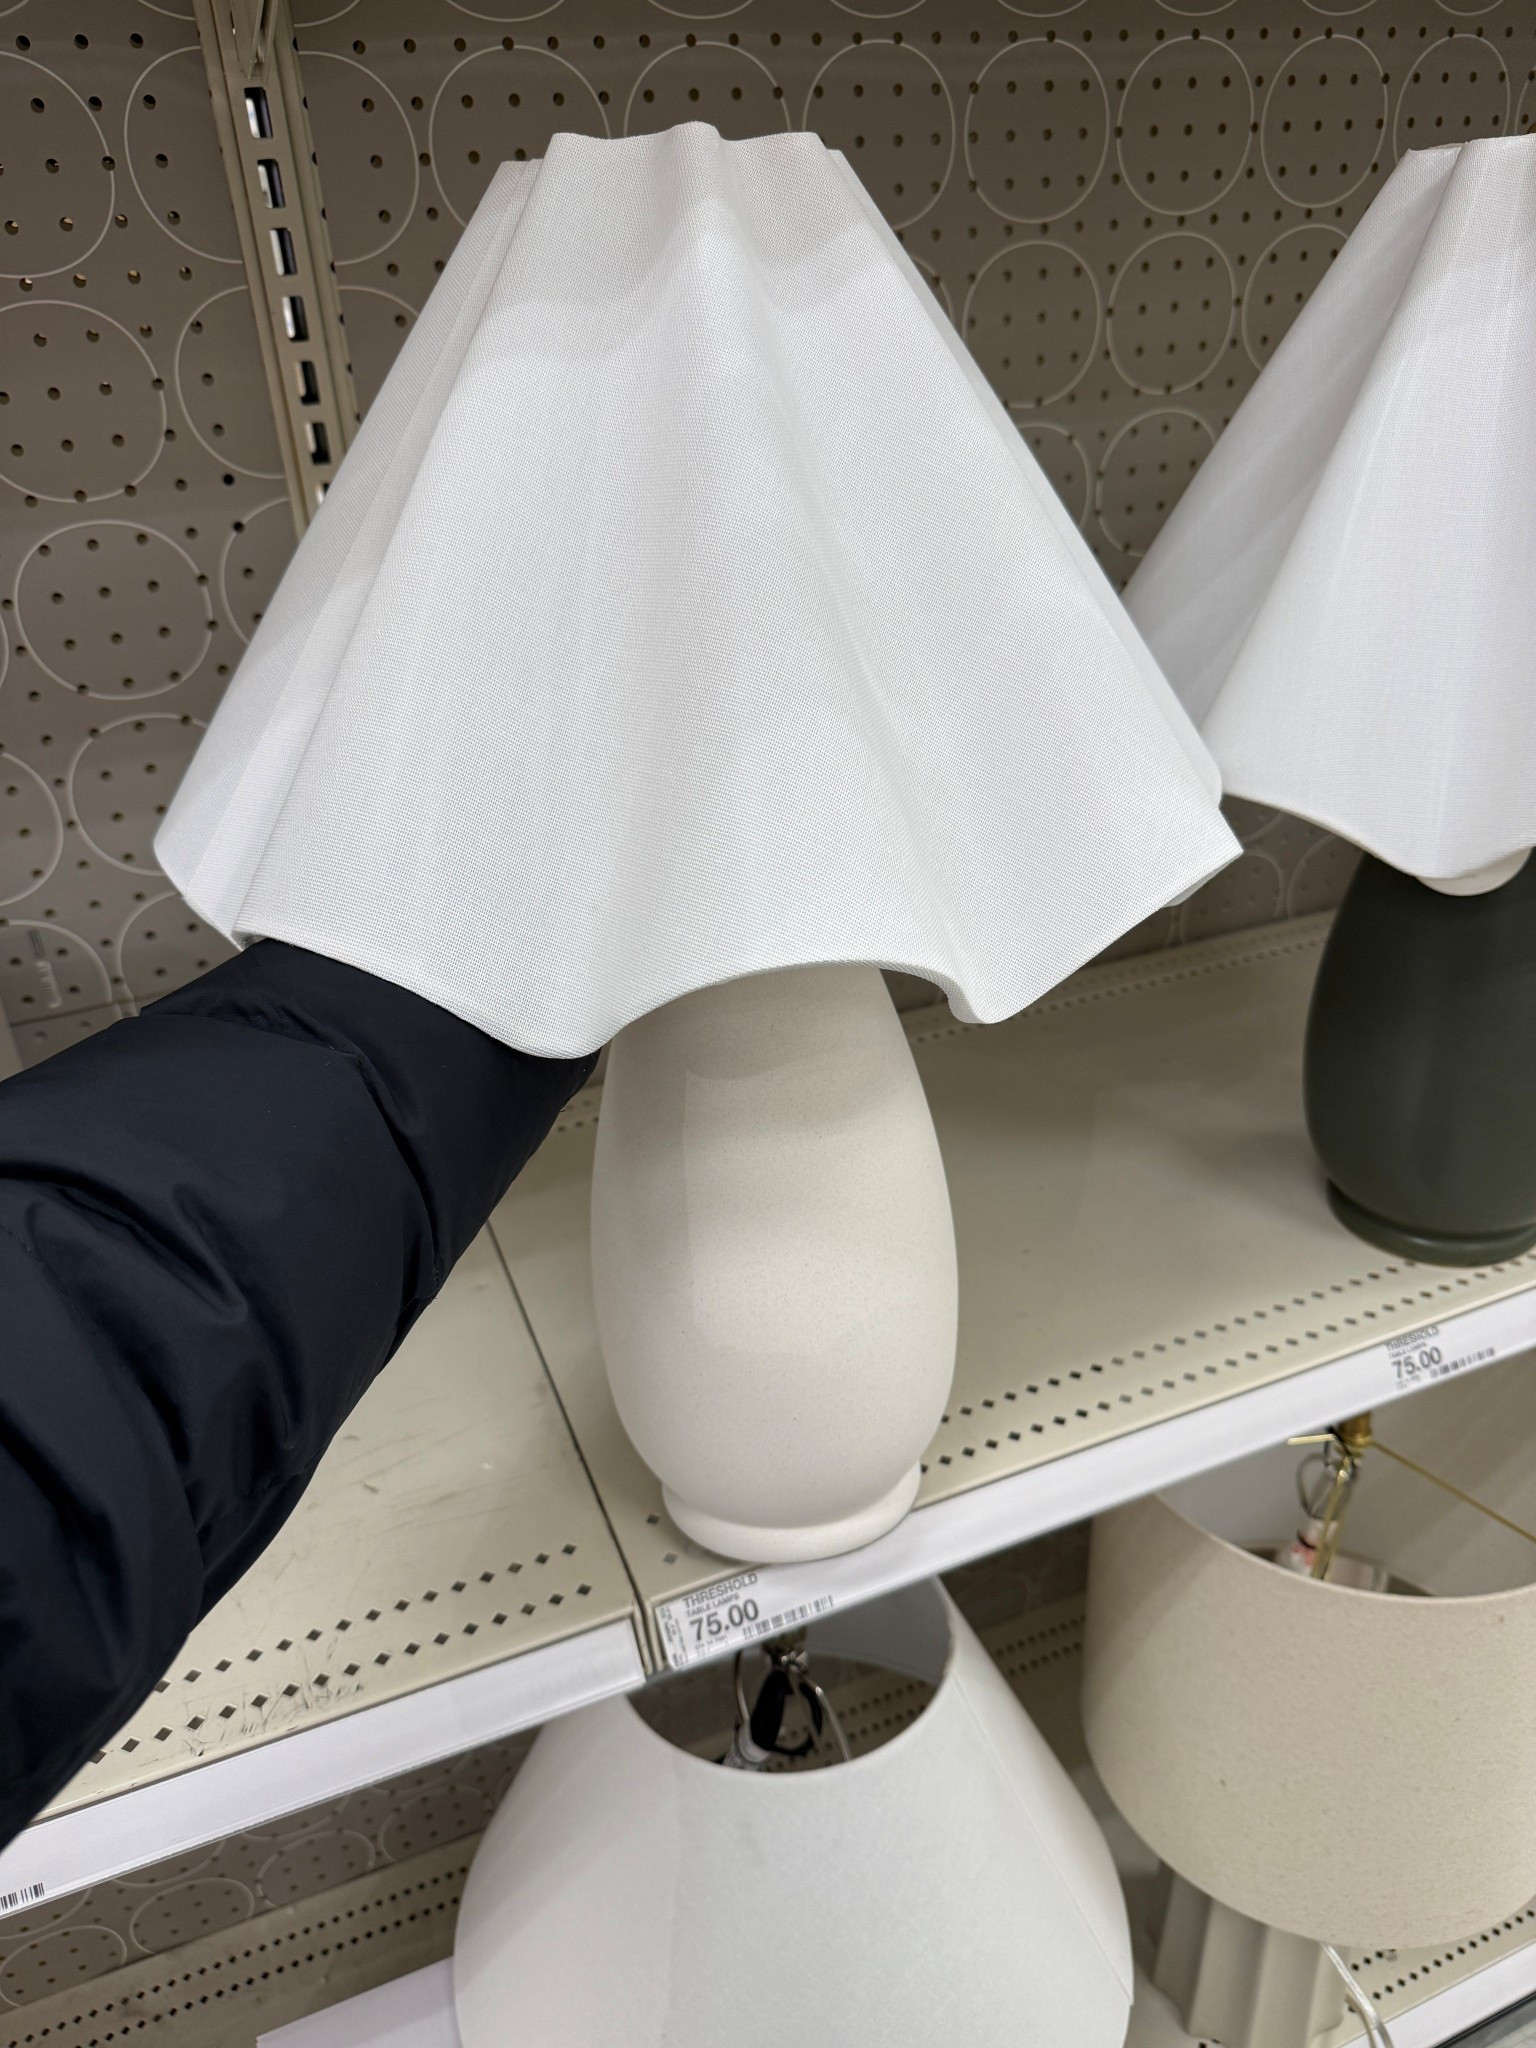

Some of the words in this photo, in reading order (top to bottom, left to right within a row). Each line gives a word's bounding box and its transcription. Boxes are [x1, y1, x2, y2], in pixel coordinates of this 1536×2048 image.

[1385, 1325, 1438, 1350] THRESHOLD
[1391, 1346, 1441, 1378] 75.00
[683, 1573, 758, 1608] THRESHOLD
[686, 1602, 712, 1617] TABLE
[690, 1598, 758, 1641] 75.00
